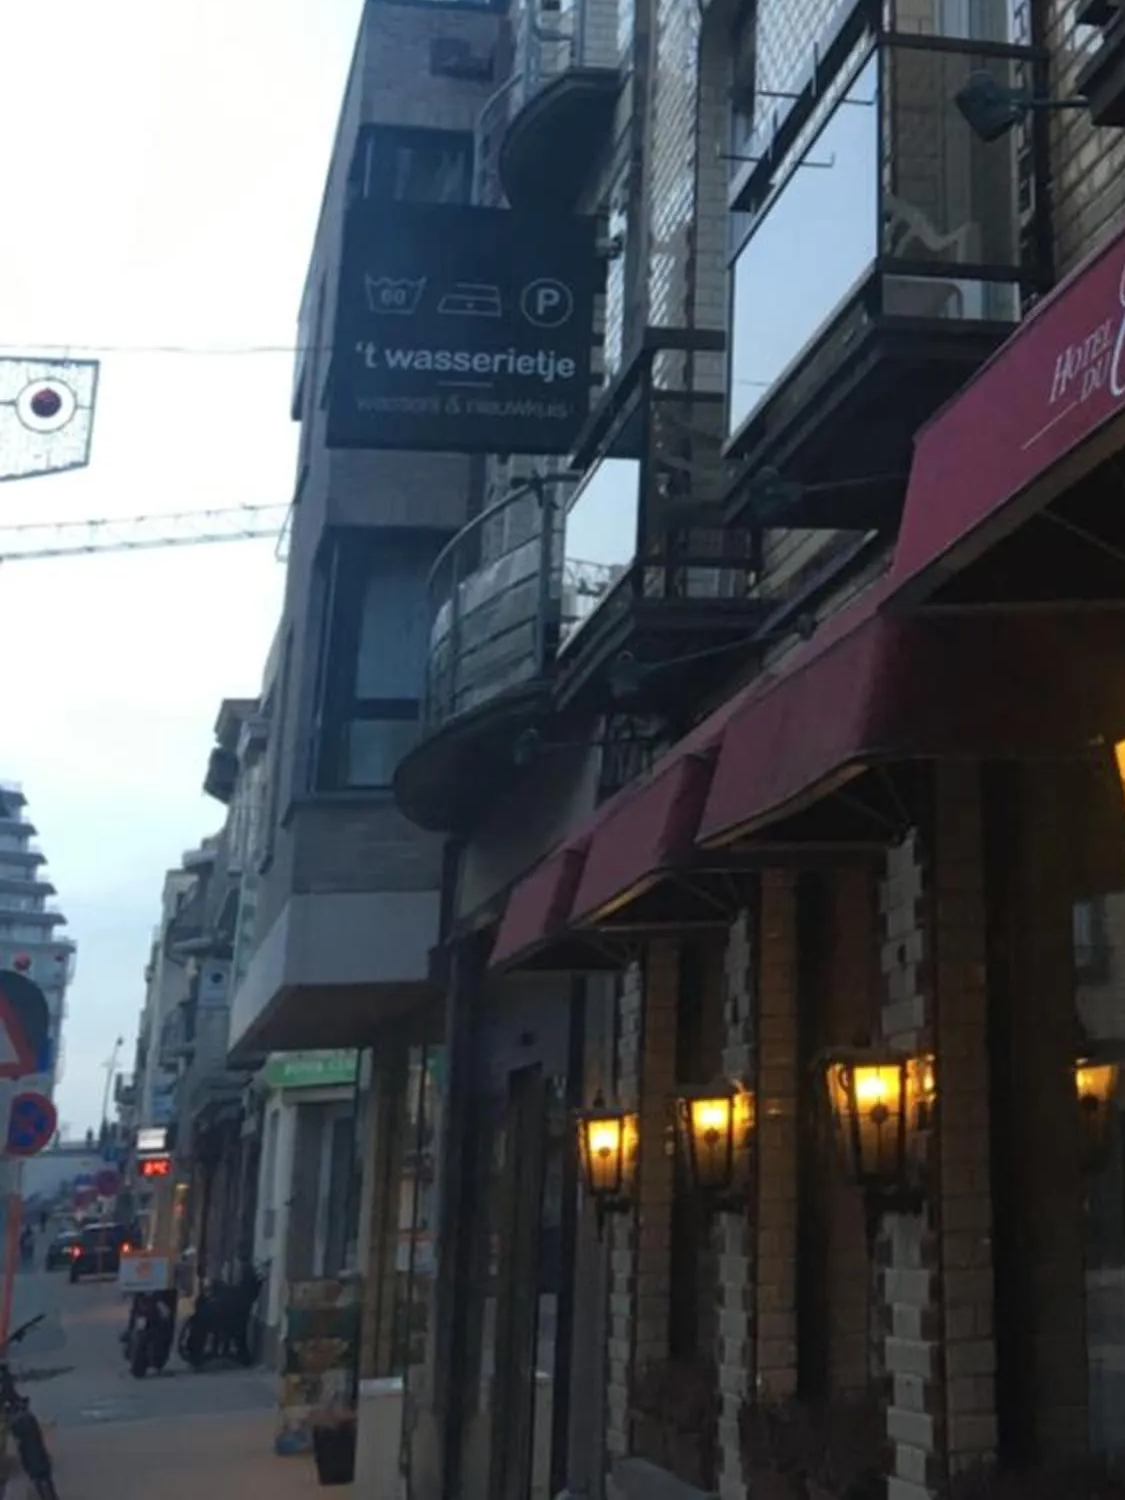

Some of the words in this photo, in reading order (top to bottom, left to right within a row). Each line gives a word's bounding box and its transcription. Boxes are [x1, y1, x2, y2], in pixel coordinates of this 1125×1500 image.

[384, 347, 577, 382] wasserietje
[1049, 316, 1113, 404] HOTEL
[1080, 348, 1112, 404] DU
